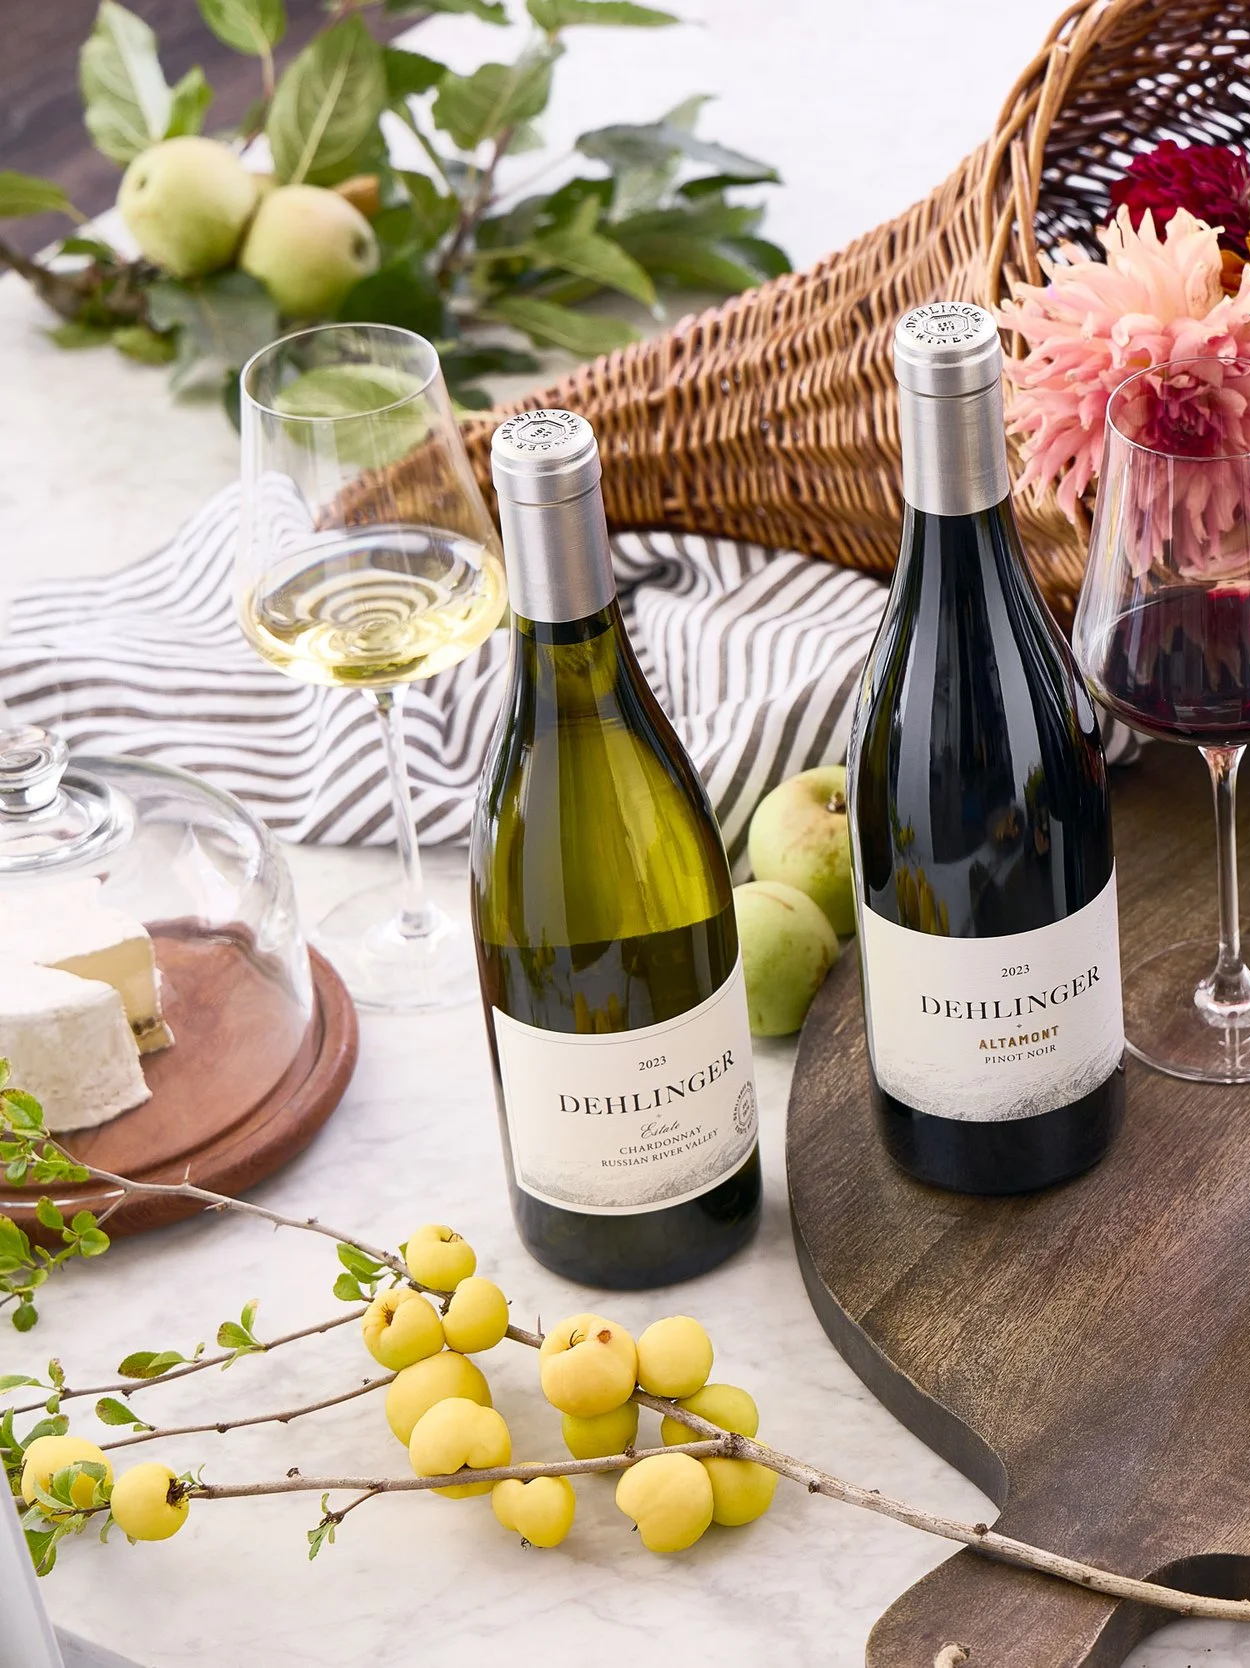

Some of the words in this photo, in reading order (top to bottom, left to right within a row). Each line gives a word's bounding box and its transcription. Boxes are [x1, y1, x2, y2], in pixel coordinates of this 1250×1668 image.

[1001, 964, 1030, 978] 2023
[921, 965, 1100, 1020] DEHLINGER
[979, 1025, 1059, 1050] ALTAMONT
[638, 1055, 667, 1071] 2023
[985, 1053, 1023, 1064] PINOT
[1027, 1044, 1057, 1059] NOIR
[559, 1049, 735, 1116] DEHLINGER
[619, 1125, 702, 1155] CHARDONNAY
[640, 1120, 680, 1139] Estate
[601, 1156, 648, 1167] RUSSIAN
[652, 1146, 684, 1162] RIVER
[685, 1128, 718, 1150] VALLEY
